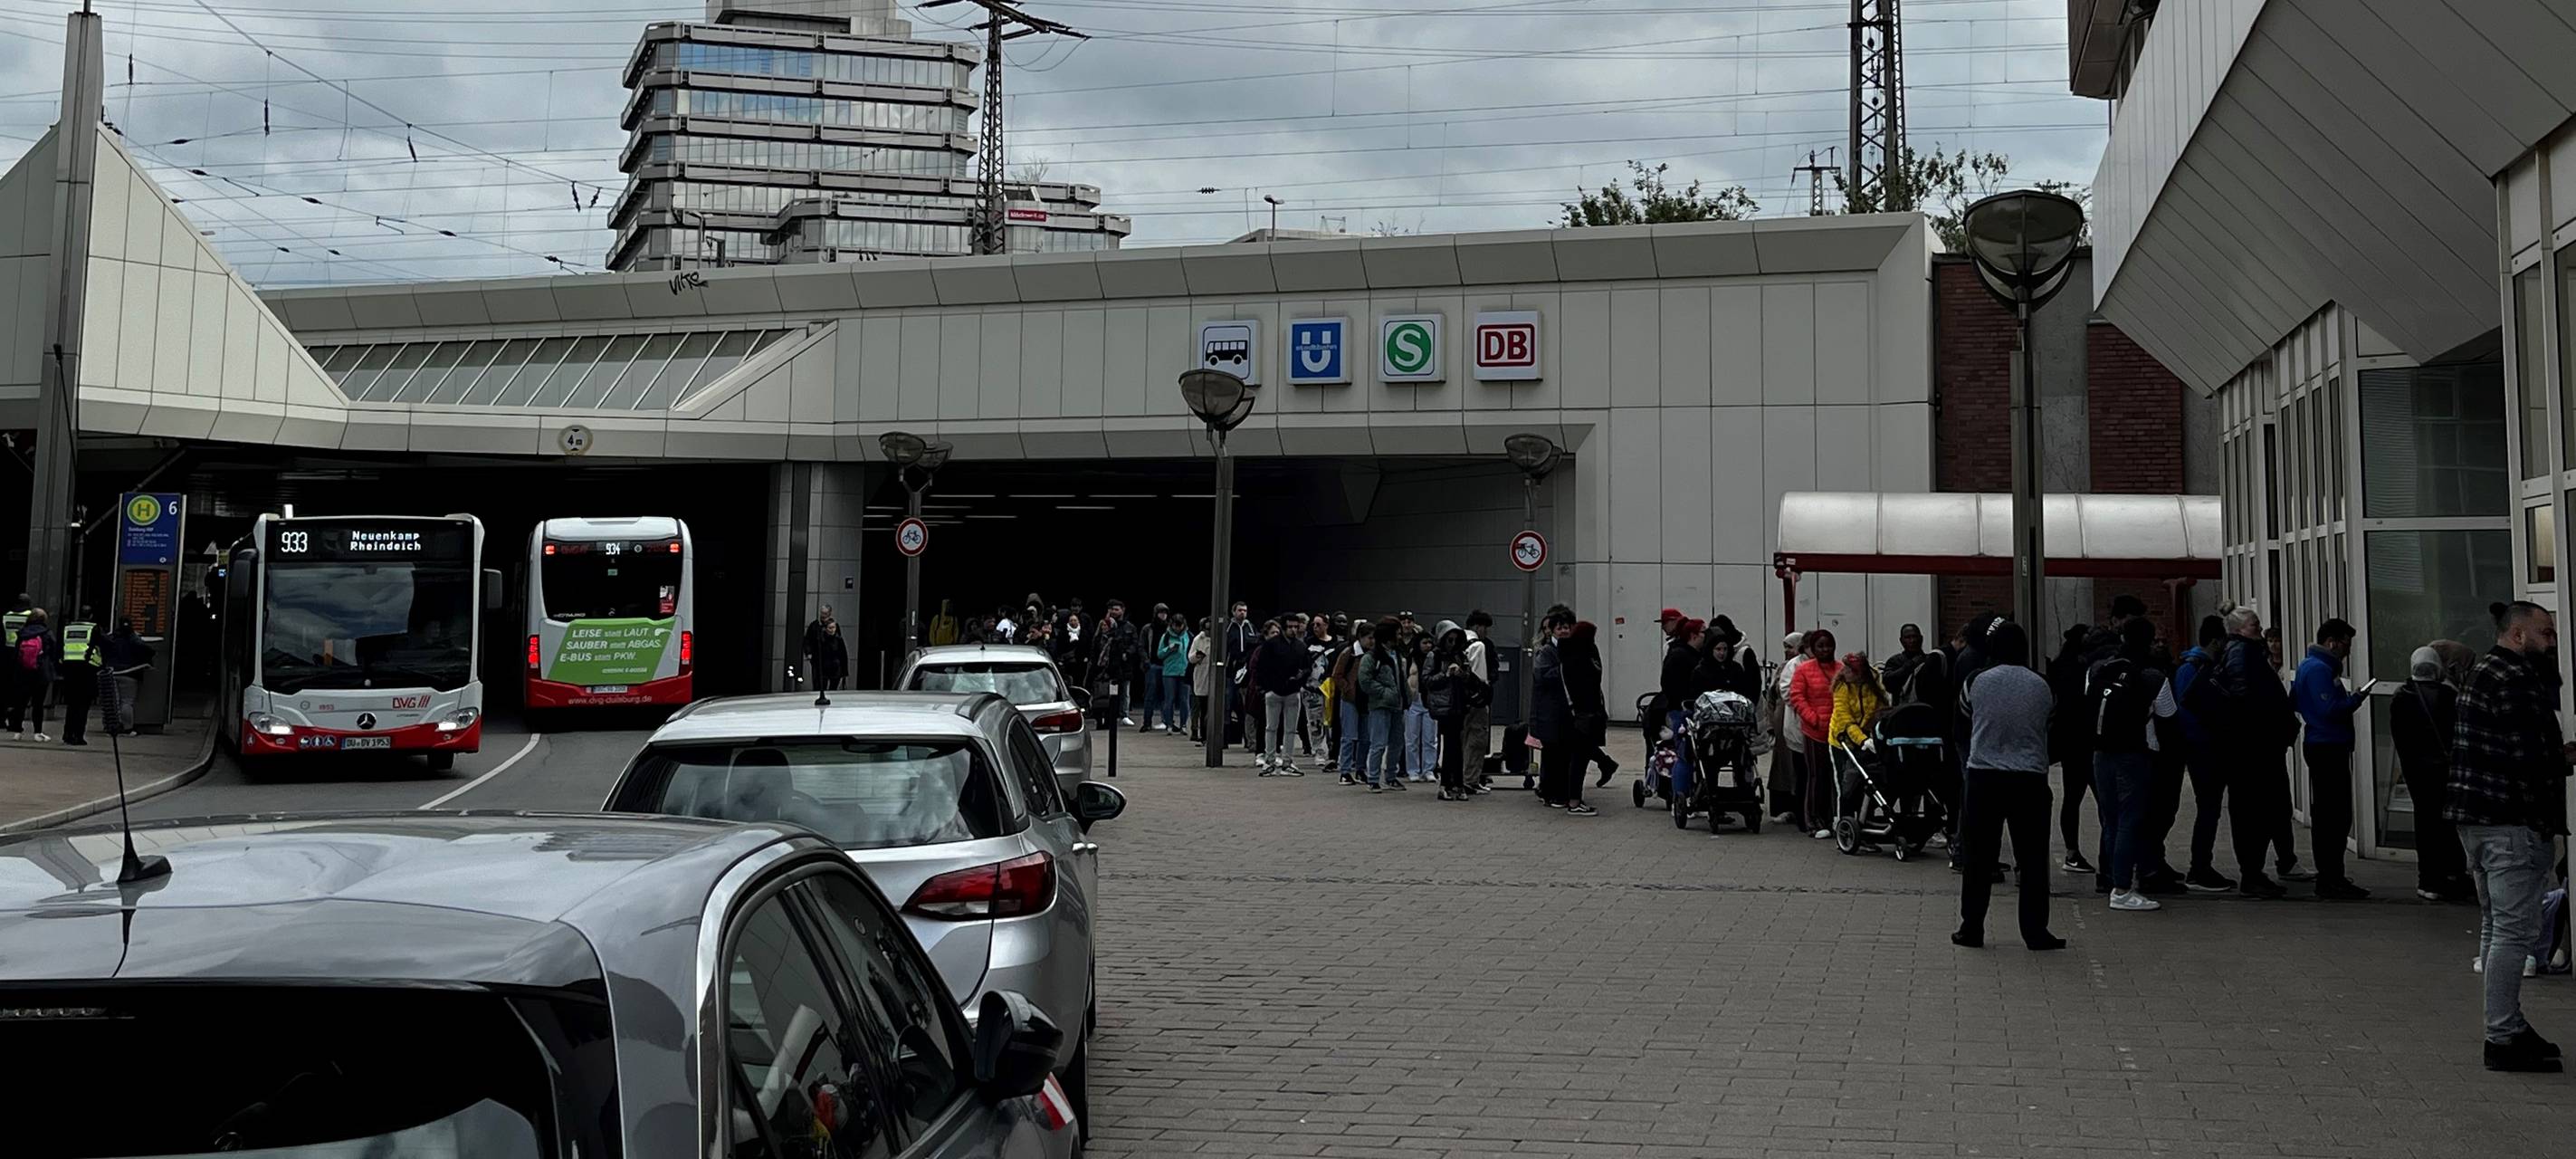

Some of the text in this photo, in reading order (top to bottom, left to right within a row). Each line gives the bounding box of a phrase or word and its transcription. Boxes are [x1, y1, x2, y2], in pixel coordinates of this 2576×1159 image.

[1394, 329, 1423, 367] S
[1484, 330, 1528, 360] DB
[138, 503, 150, 517] H
[168, 501, 177, 515] 6
[352, 530, 420, 541] Neuenkamp
[281, 532, 308, 553] 933
[350, 541, 421, 551] Rheindeich
[606, 542, 621, 555] 934
[572, 628, 602, 638] LEISE
[566, 640, 608, 650] SAUBER
[559, 653, 592, 662] E-BUS
[392, 696, 416, 709] DVG
